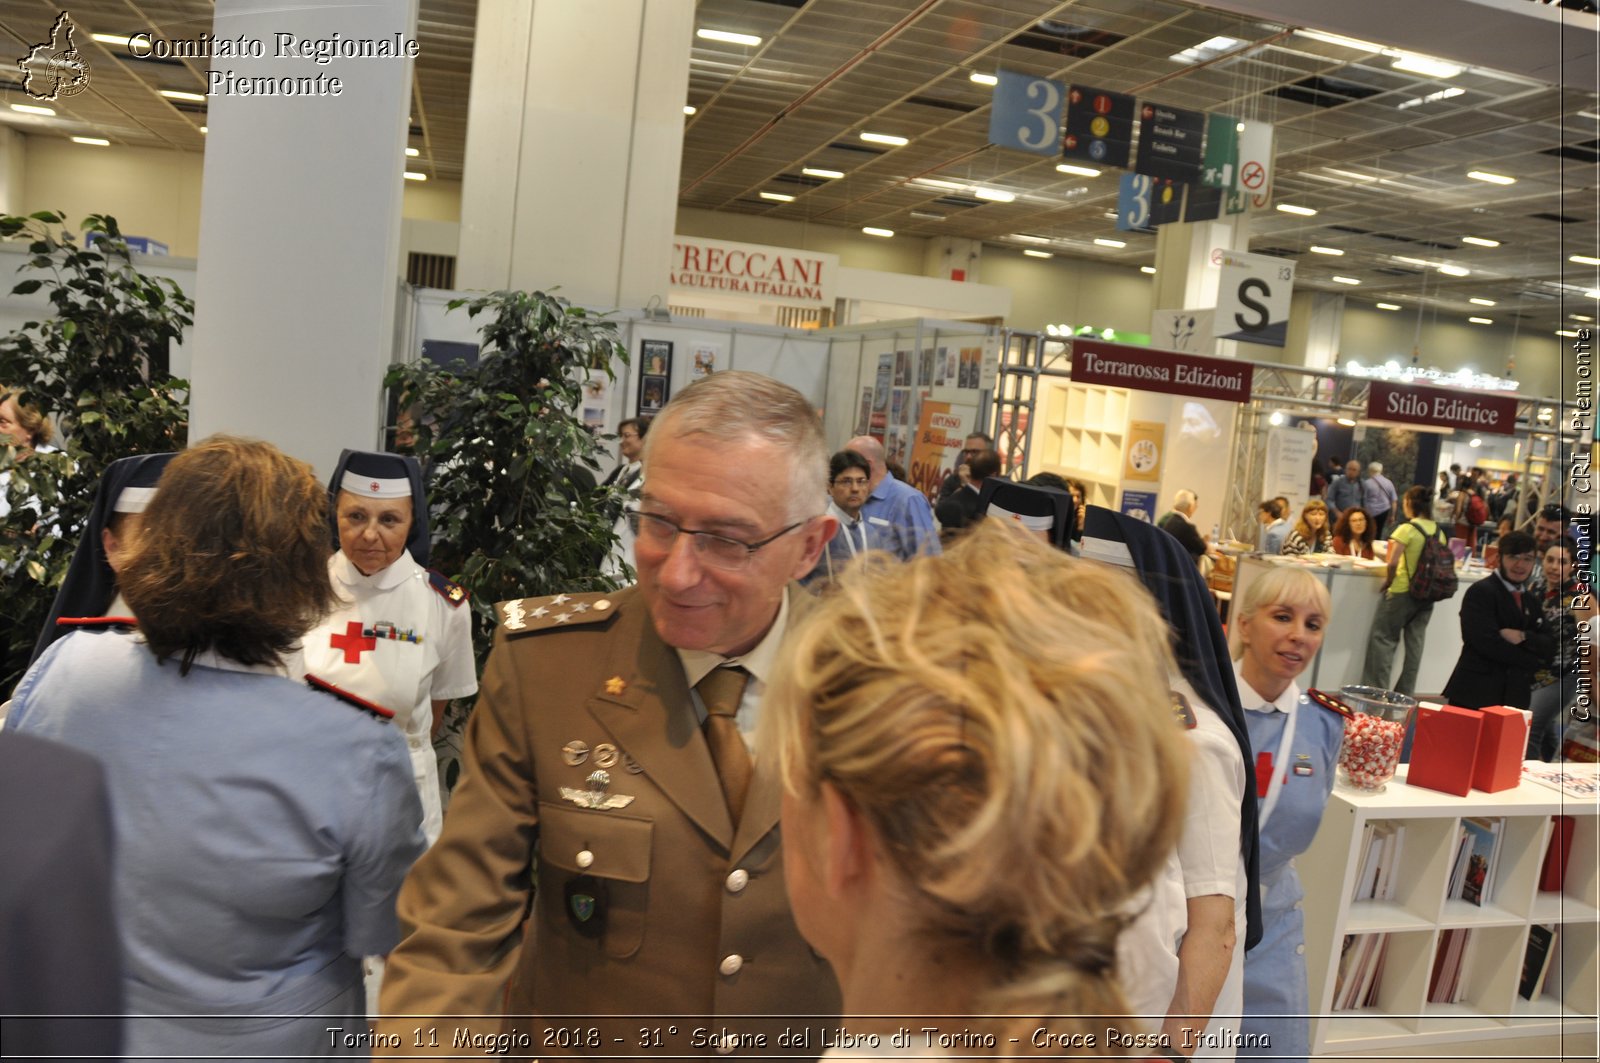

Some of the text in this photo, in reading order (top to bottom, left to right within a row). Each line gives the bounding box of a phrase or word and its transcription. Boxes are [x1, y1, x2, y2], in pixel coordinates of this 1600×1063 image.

[1018, 80, 1060, 149] 3
[1098, 97, 1106, 112] 1
[1128, 174, 1150, 227] 3
[673, 244, 824, 286] RECCANI
[1283, 267, 1291, 281] 3
[679, 273, 750, 292] CULTURA
[753, 281, 822, 300] ITALIANA
[1235, 278, 1271, 332] S
[1083, 352, 1242, 391] Terrarossa Edizioni
[1387, 392, 1499, 425] Stilo Editrice
